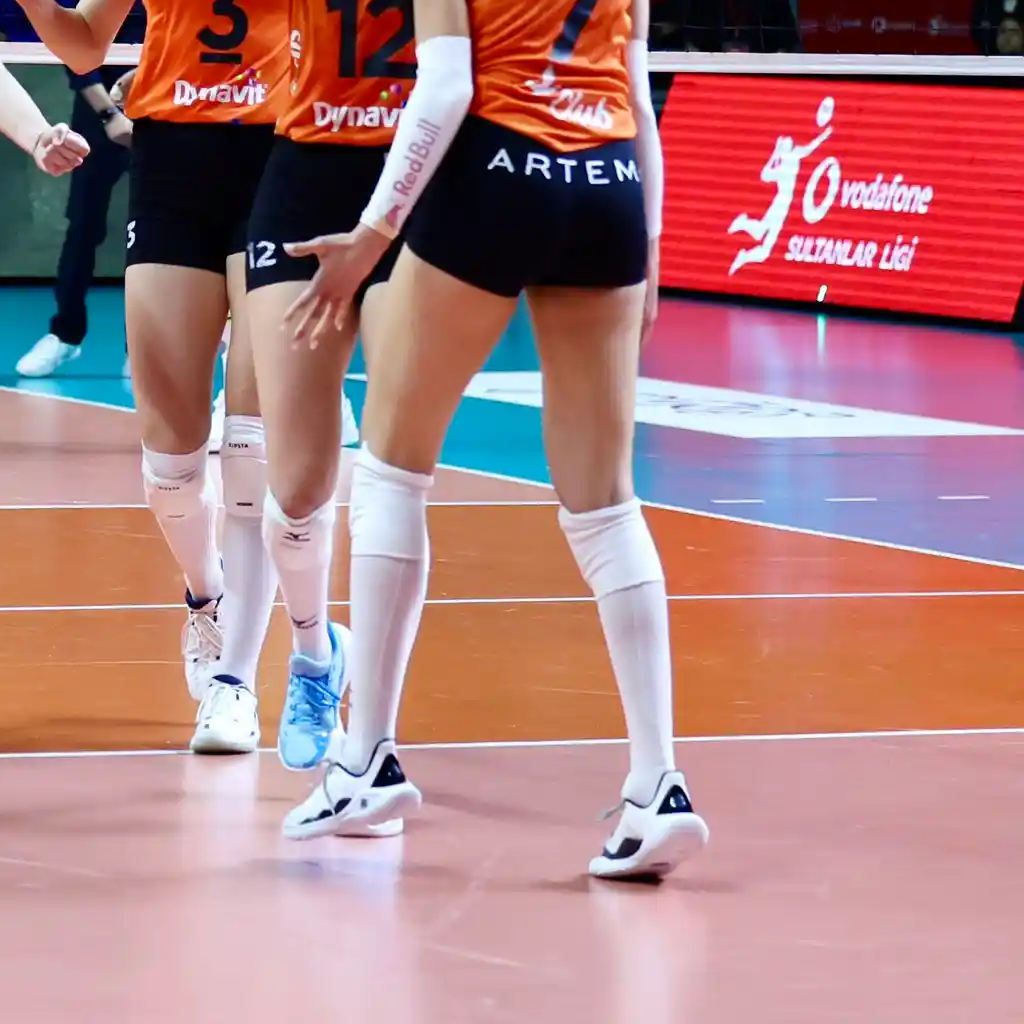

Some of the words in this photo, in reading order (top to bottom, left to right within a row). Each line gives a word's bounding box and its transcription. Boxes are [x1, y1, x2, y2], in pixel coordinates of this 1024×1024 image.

[172, 80, 267, 106] Dynavit
[313, 101, 403, 132] Dynav
[487, 148, 641, 185] ARTEM
[840, 172, 934, 214] vodafone
[246, 240, 277, 270] 12
[784, 234, 878, 268] SULTANLAR
